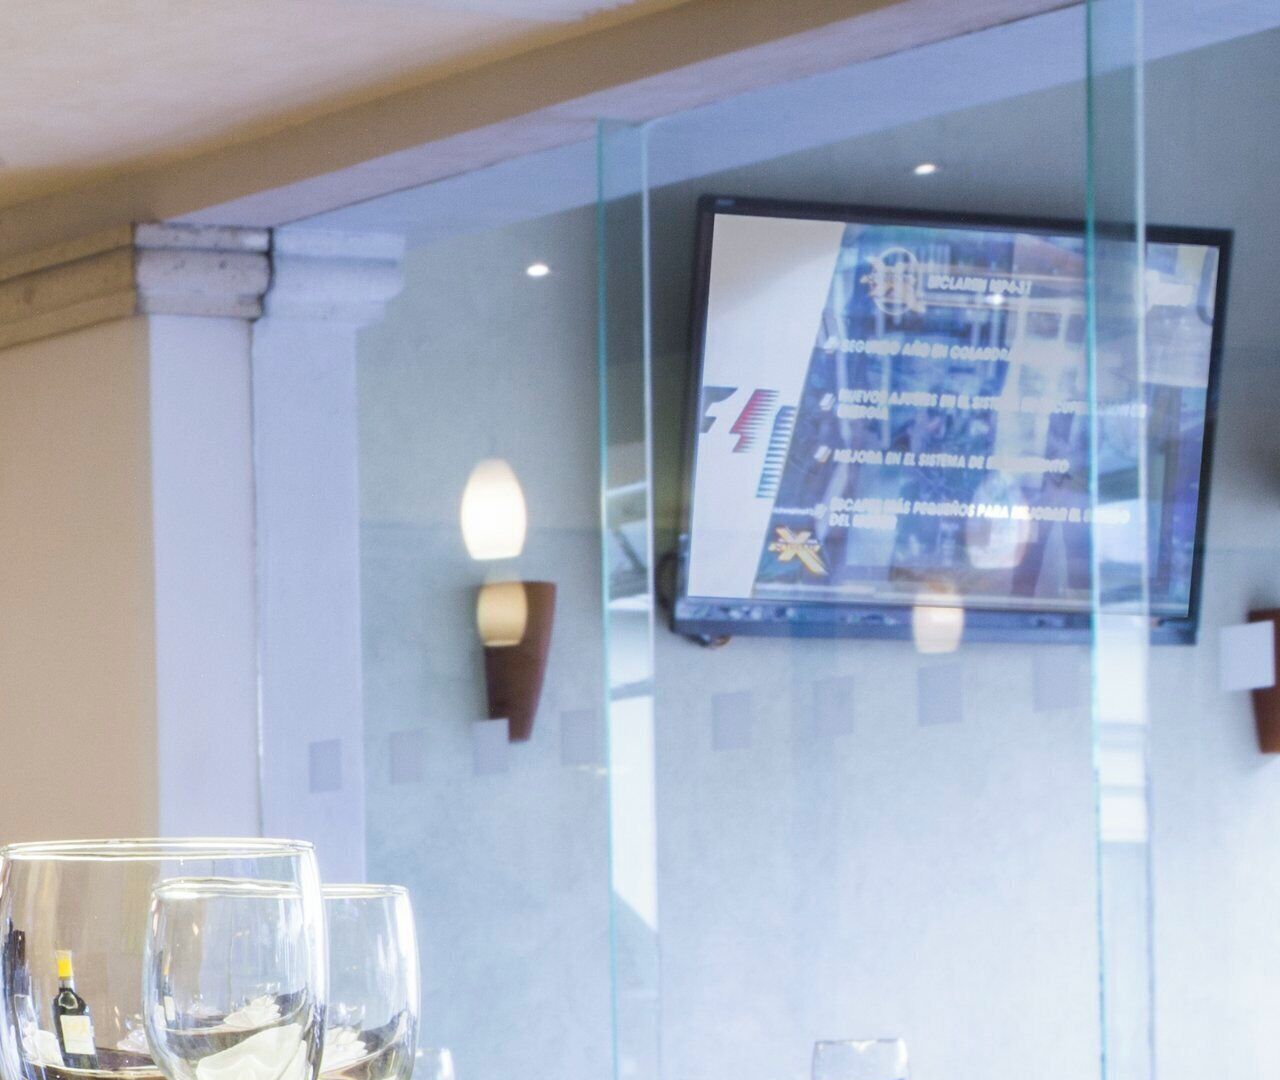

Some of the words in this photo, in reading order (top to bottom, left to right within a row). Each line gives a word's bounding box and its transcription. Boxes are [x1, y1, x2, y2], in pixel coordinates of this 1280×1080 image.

[840, 338, 901, 356] SEGUO
[838, 387, 888, 405] NUEVO
[833, 448, 883, 465] MEJORA
[917, 452, 966, 468] SISTEMA
[976, 503, 1009, 519] PARA
